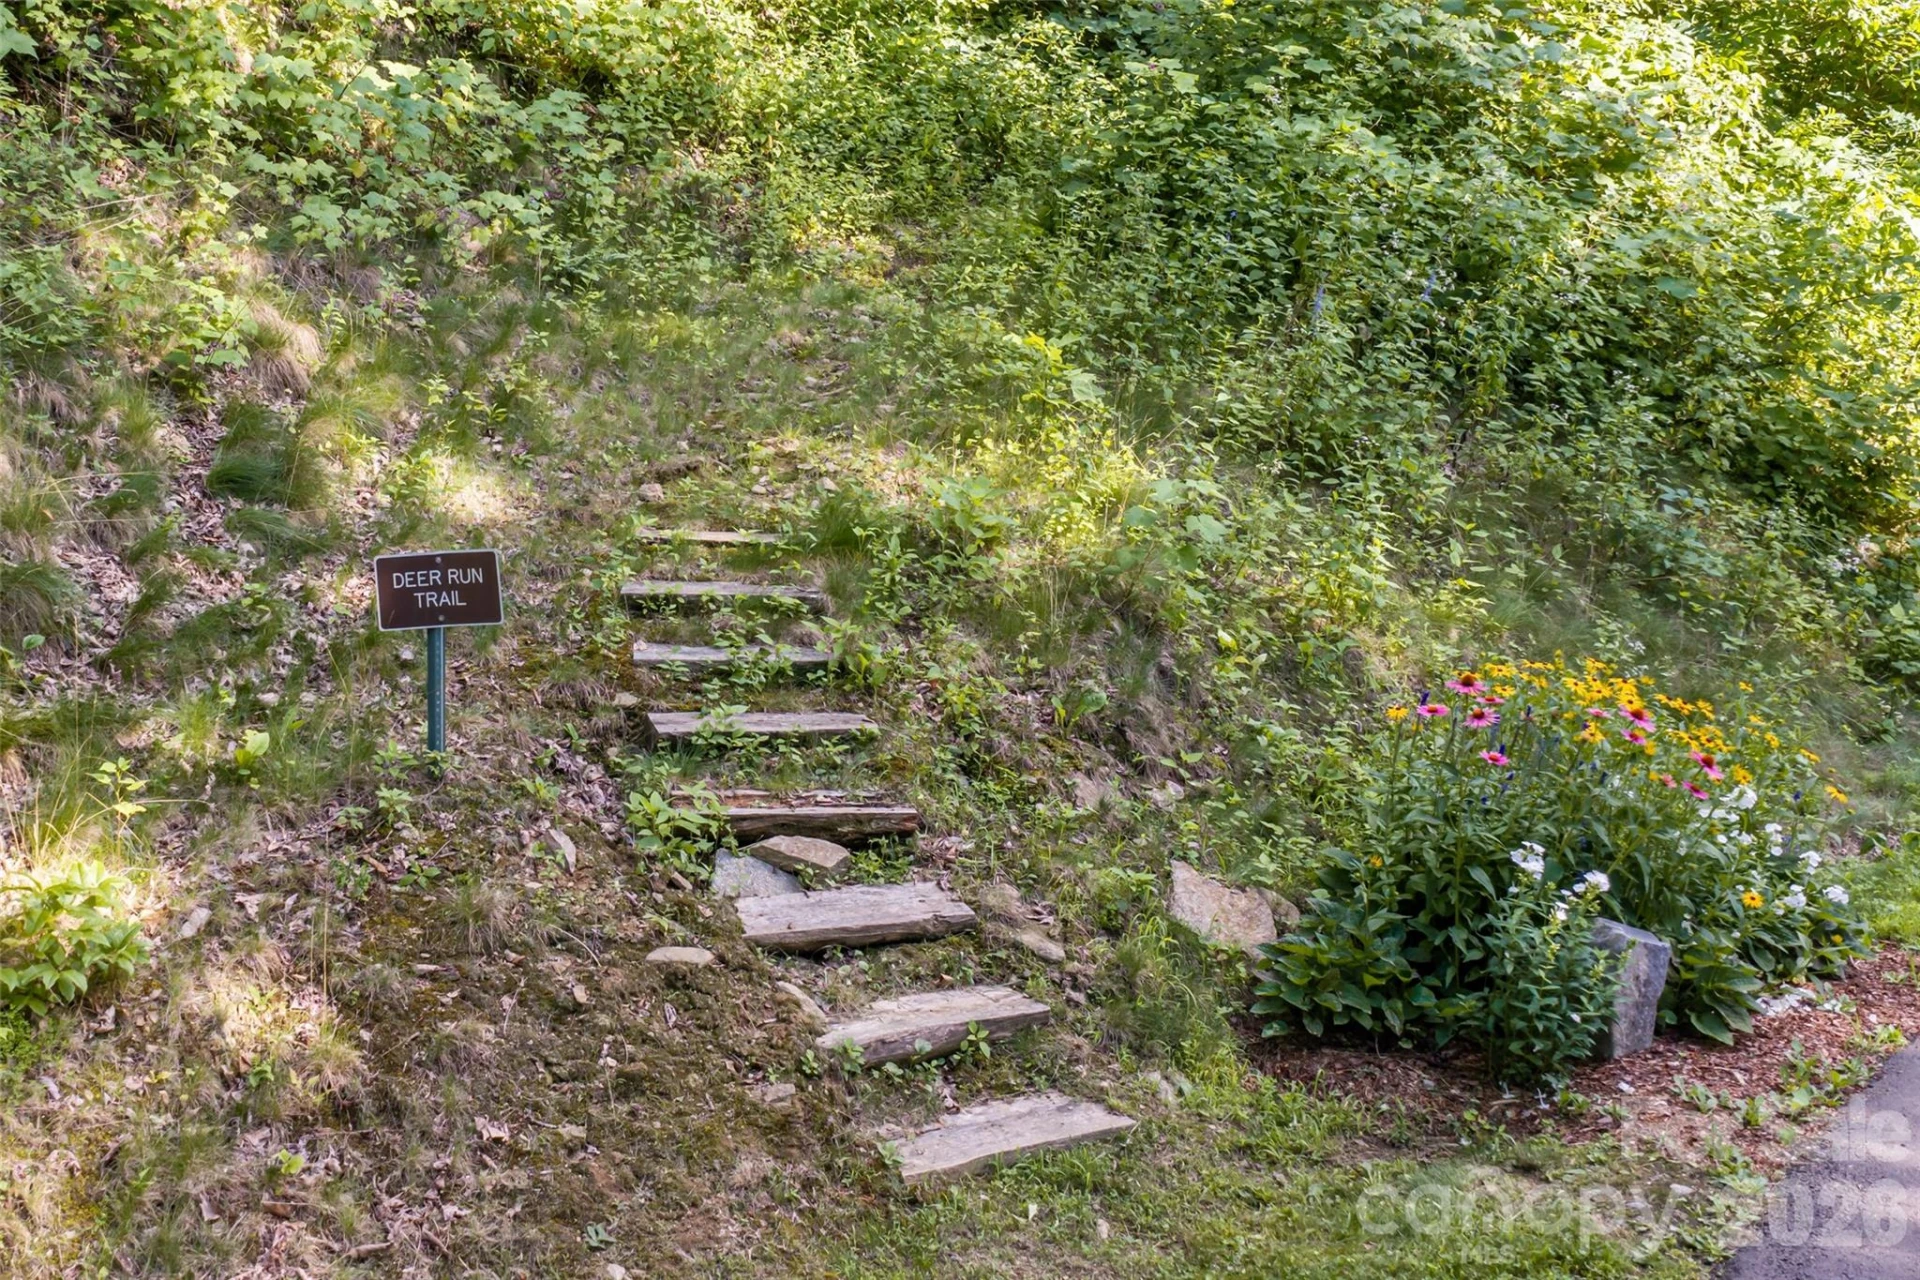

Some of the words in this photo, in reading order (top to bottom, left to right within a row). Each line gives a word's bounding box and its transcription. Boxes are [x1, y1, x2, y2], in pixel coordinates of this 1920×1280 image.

[392, 569, 442, 589] DEER
[447, 567, 483, 585] RUN
[413, 590, 467, 608] TRAIL
